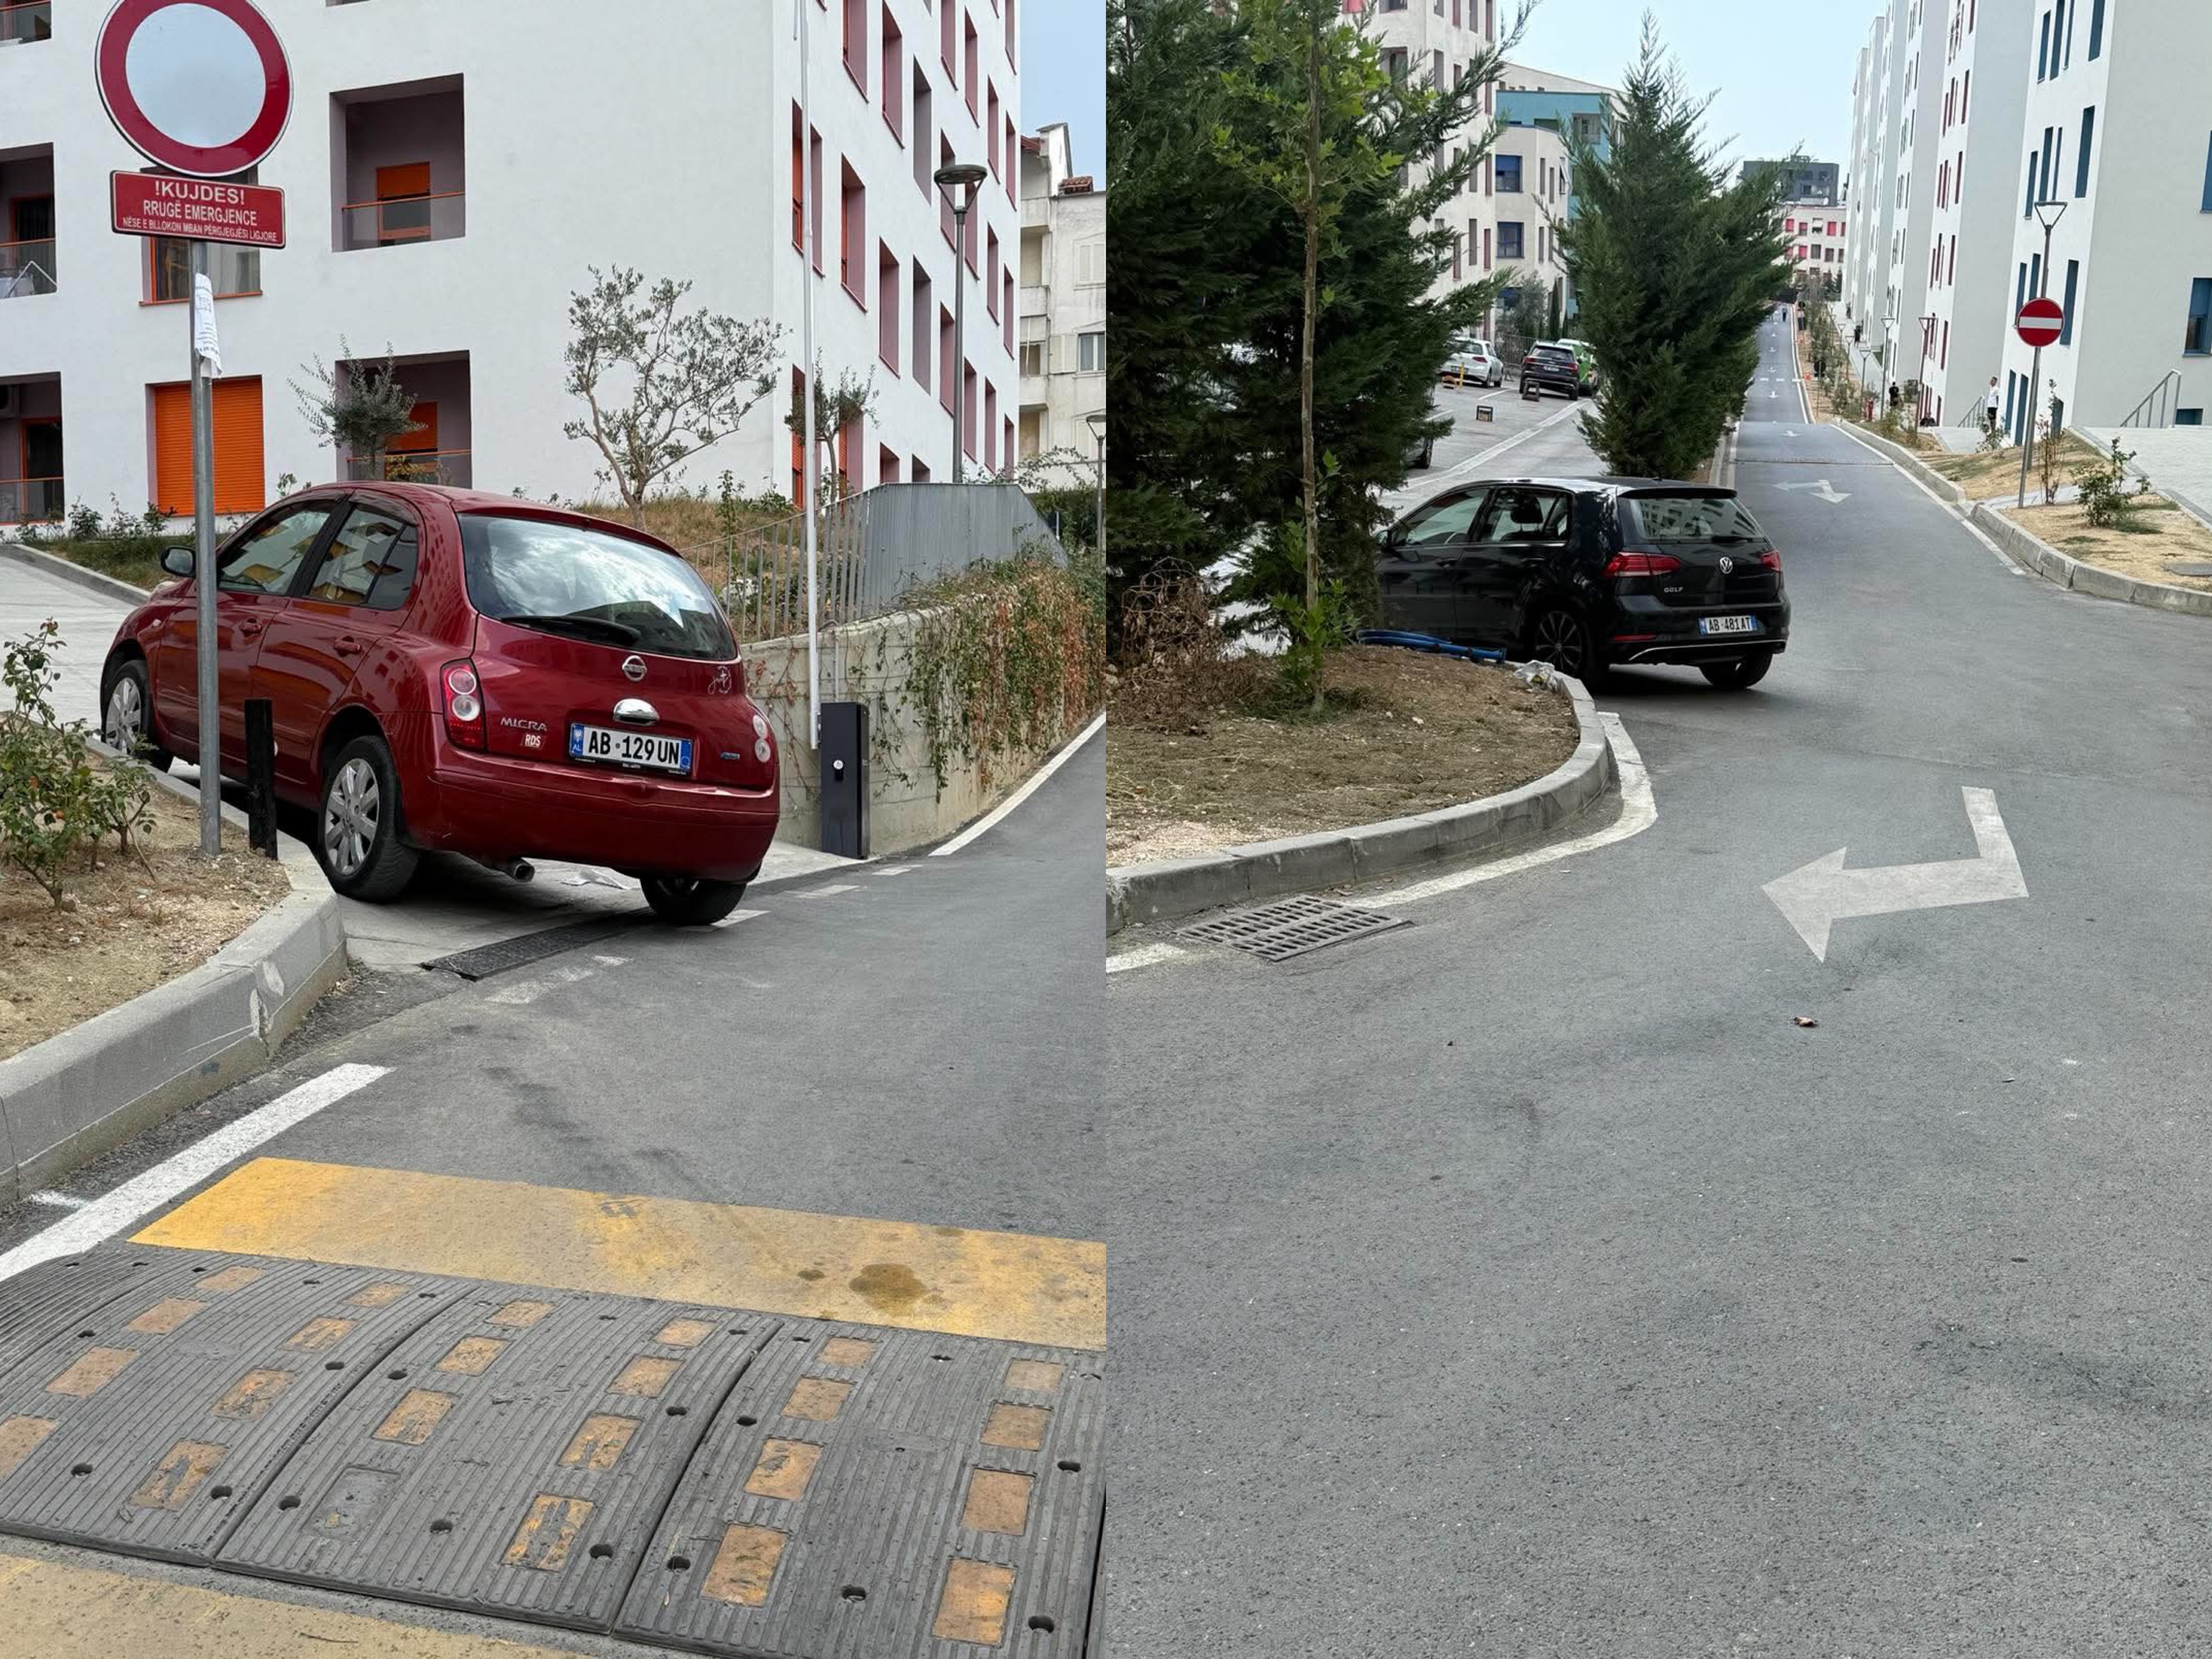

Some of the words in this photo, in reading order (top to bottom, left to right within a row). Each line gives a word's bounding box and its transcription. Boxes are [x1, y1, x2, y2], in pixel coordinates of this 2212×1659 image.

[155, 180, 245, 205] !KUJDES!
[144, 200, 182, 218] RRUGË
[185, 204, 257, 226] EMERGJENCE
[123, 216, 141, 228] NËSE
[143, 218, 147, 229] E
[149, 219, 181, 232] BLLOKON
[183, 223, 202, 234] MBAN
[204, 224, 249, 239] PËRGJEGJËSI
[1709, 619, 1719, 632] AB
[1725, 618, 1740, 630] 481
[1741, 617, 1751, 630] AT
[500, 717, 548, 731] MICRA
[525, 734, 541, 748] RDS
[573, 743, 582, 752] AL
[588, 731, 611, 755] AB
[622, 735, 654, 761] 129
[657, 740, 679, 765] UN
